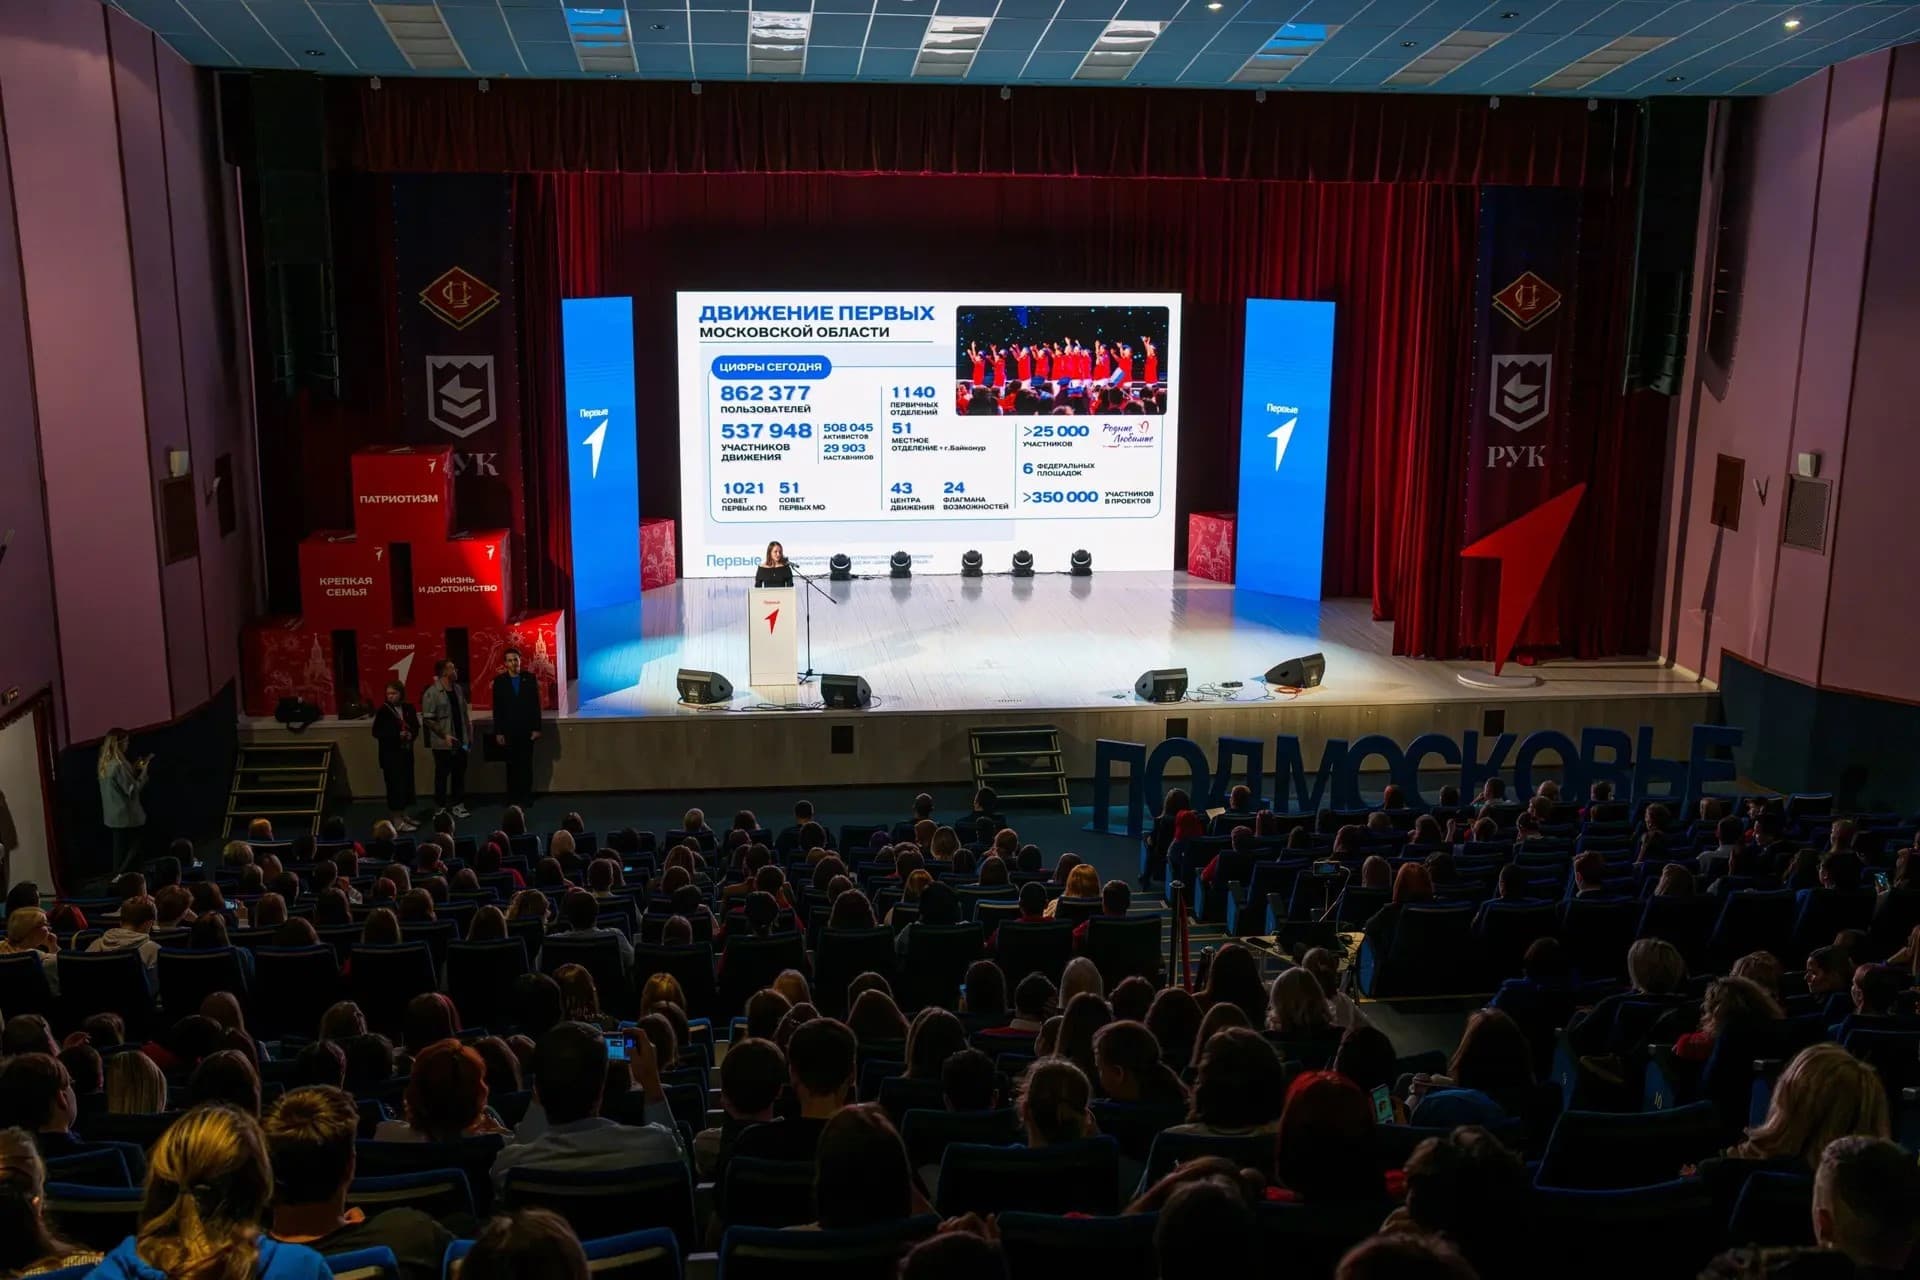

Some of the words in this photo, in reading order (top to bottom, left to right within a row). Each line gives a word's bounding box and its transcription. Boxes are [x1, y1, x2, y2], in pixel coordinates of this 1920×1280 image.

[699, 305, 834, 323] ДВИЖЕНИЕ
[839, 305, 935, 321] ПЕРВЫХ
[700, 325, 813, 338] МОСКОВСКОЙ
[816, 327, 890, 338] ОБЛАСТИ
[719, 363, 765, 373] ЦИФРЫ
[767, 363, 822, 373] СЕГОДНЯ
[721, 385, 764, 401] 862
[768, 385, 811, 401] 377
[892, 386, 936, 398] 1140
[579, 408, 609, 419] Первые
[721, 404, 811, 413] ПОЛЬЗОВАТЕЛЕЙ
[1267, 403, 1298, 414] Первые
[721, 423, 764, 439] 537
[769, 423, 812, 439] 948
[823, 423, 847, 432] 508
[849, 423, 874, 432] 045
[892, 423, 912, 434] 51
[1057, 426, 1090, 437] 000
[721, 443, 790, 452] УЧАСТНИКОВ
[823, 444, 840, 453] 29
[842, 444, 866, 453] 903
[721, 453, 782, 462] ДВИЖЕНИЯ
[1487, 445, 1548, 468] РУК
[453, 453, 499, 476] УК
[1023, 462, 1034, 474] 6
[723, 483, 764, 494] 1021
[779, 482, 799, 494] 51
[890, 482, 913, 494] 43
[943, 482, 965, 494] 24
[359, 494, 439, 504] ПАТРИОТИЗМ
[1066, 491, 1099, 503] 000
[943, 503, 1009, 511] ВОЗМОЖНОСТЕЙ
[707, 554, 762, 570] Первые
[319, 577, 373, 586] КРЕПКАЯ
[440, 576, 475, 584] ЖИЗНЬ
[326, 588, 367, 597] СЕМЬЯ
[427, 584, 497, 594] ДОСТОИНСТВО
[1094, 723, 1745, 836] ПОДМОСКОВЬЕ
